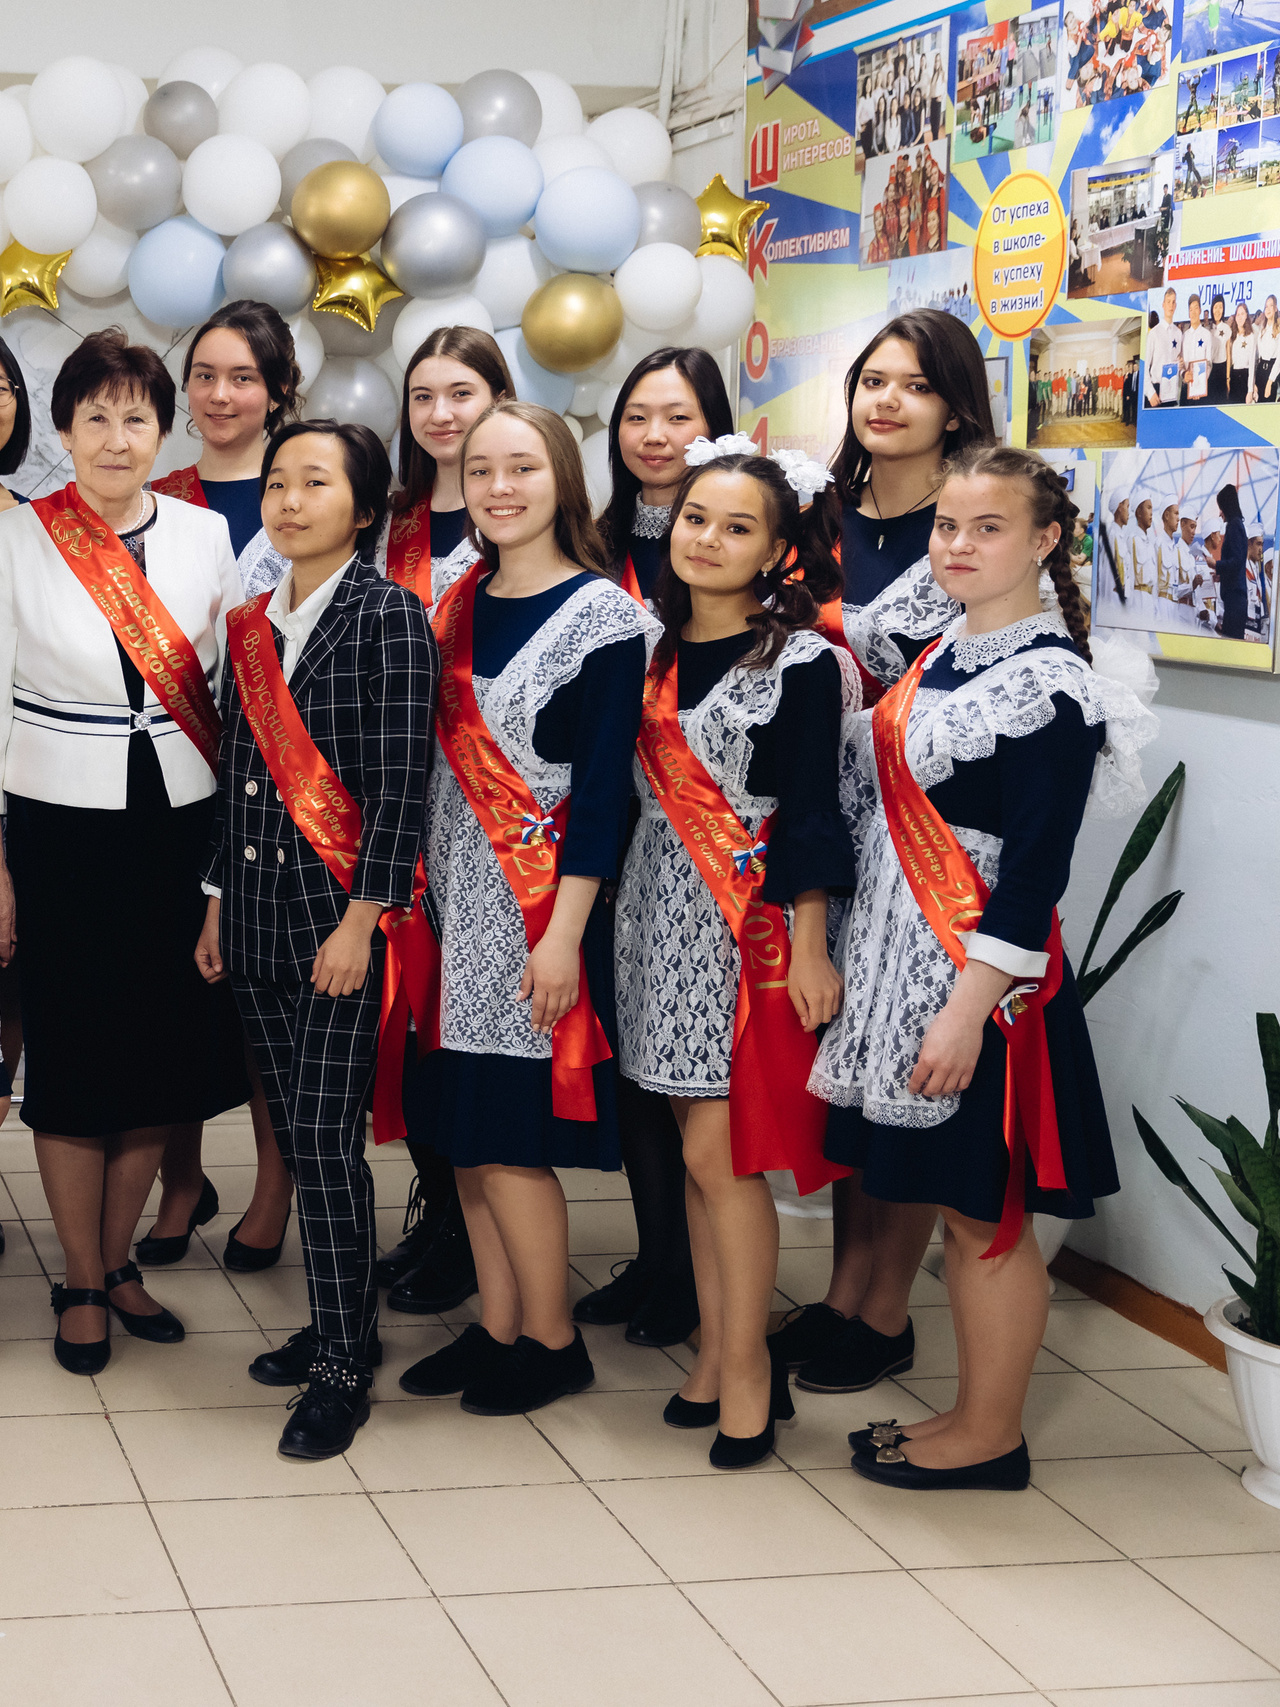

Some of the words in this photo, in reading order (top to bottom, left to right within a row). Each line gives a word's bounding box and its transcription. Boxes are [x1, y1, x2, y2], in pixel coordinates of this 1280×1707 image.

[782, 136, 852, 172] ИНТЕРЕСОВ
[992, 207, 1006, 223] От
[1010, 201, 1049, 224] успеха
[993, 241, 1000, 253] в
[1003, 234, 1045, 252] школе-
[1168, 247, 1225, 269] ДВИЖЕНИЕ
[994, 269, 1000, 283] к
[1003, 263, 1043, 285] успеху
[990, 301, 997, 313] в
[1000, 290, 1043, 312] жизни!
[90, 583, 120, 622] класс
[107, 564, 191, 671] Классный
[441, 595, 463, 726] Выпускник
[234, 659, 251, 706] Жапова
[247, 704, 270, 750] Сурана
[242, 629, 295, 765] Выпускник
[459, 725, 483, 767] «СОШ
[478, 767, 503, 798] №8»
[477, 737, 505, 775] МАОУ
[317, 778, 351, 814] МАОУ
[461, 763, 485, 801] класс
[295, 771, 326, 810] «СОШ
[319, 809, 347, 840] №8»
[300, 808, 332, 846] класс
[696, 803, 726, 848] «СОШ
[721, 812, 752, 851] МАОУ
[900, 803, 928, 846] «СОШ
[922, 847, 946, 882] №8»
[920, 813, 952, 853] МАОУ
[489, 800, 559, 899] 2021
[698, 842, 727, 880] класс
[904, 843, 928, 886] класс
[728, 886, 789, 990] 2021
